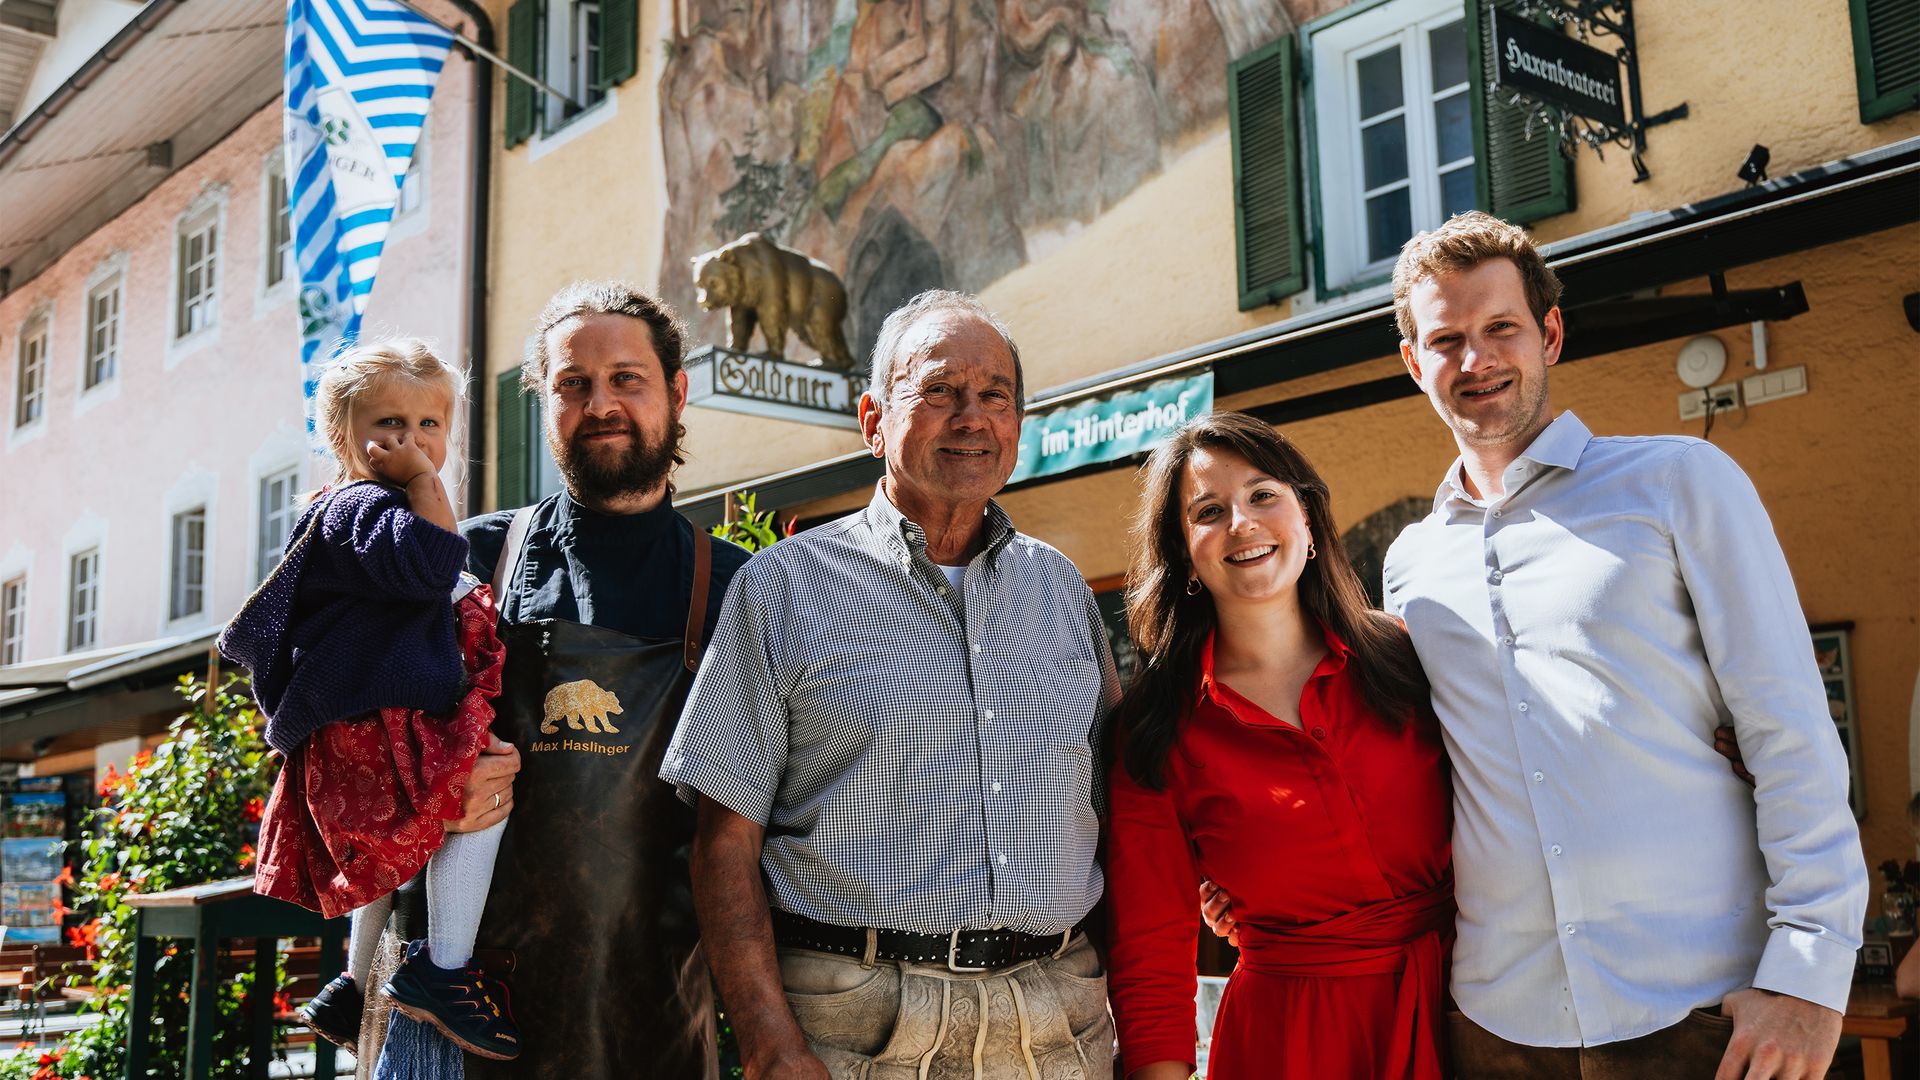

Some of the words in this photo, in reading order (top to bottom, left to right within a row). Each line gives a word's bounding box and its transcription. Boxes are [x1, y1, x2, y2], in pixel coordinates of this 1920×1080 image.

[1505, 37, 1617, 106] Haxenbraterei
[719, 355, 832, 409] Goldener
[1041, 426, 1070, 457] im
[1073, 390, 1195, 449] Hinterhof
[529, 741, 559, 752] Max
[563, 739, 631, 756] Haslinger
